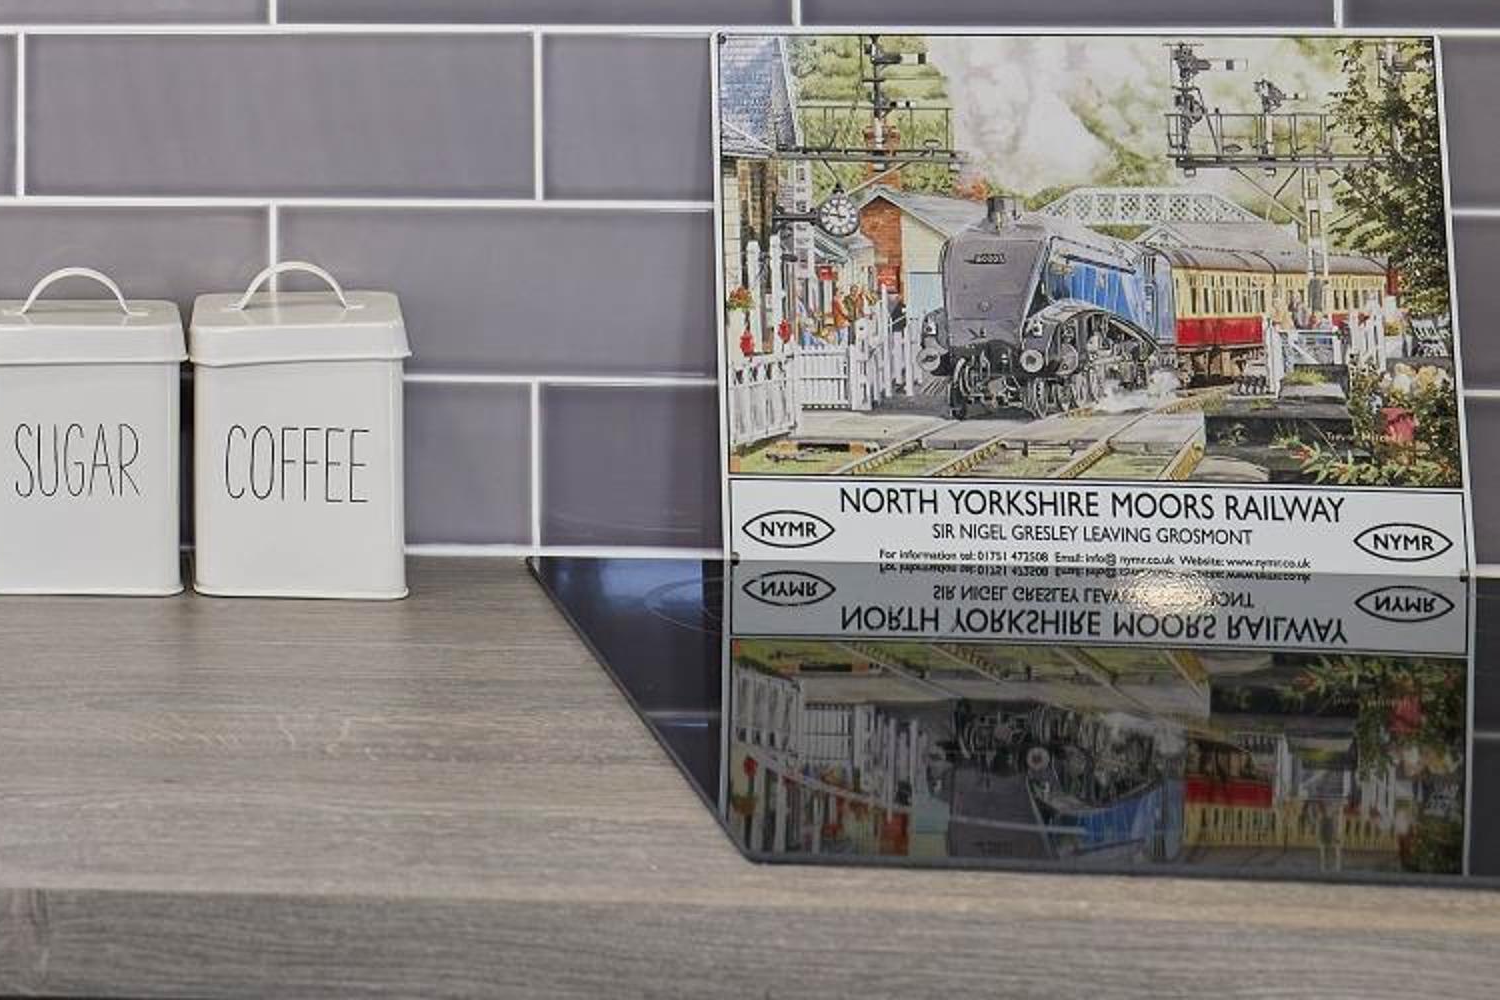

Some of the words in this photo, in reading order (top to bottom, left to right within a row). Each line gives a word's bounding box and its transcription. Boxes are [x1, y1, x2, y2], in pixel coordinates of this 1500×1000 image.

[15, 424, 139, 498] SUGAR
[226, 425, 369, 502] COFFEE
[841, 488, 937, 514] NORTH
[948, 490, 1099, 516] YORKSHIRE
[1112, 492, 1214, 520] MOORS
[1226, 495, 1344, 522] RAILWAY
[760, 521, 818, 538] NYMR
[933, 524, 955, 538] SIR
[960, 524, 1007, 540] NIGEL
[1012, 525, 1078, 541] GRESLEY
[1084, 526, 1151, 542] LEAVING
[1156, 528, 1252, 544] GROSMONT
[1373, 533, 1435, 551] NYMR
[879, 549, 897, 559] For
[900, 549, 956, 560] information
[978, 551, 1007, 561] 01751
[1180, 556, 1225, 566] Website:
[1226, 558, 1311, 569] www.nymr.co.uk
